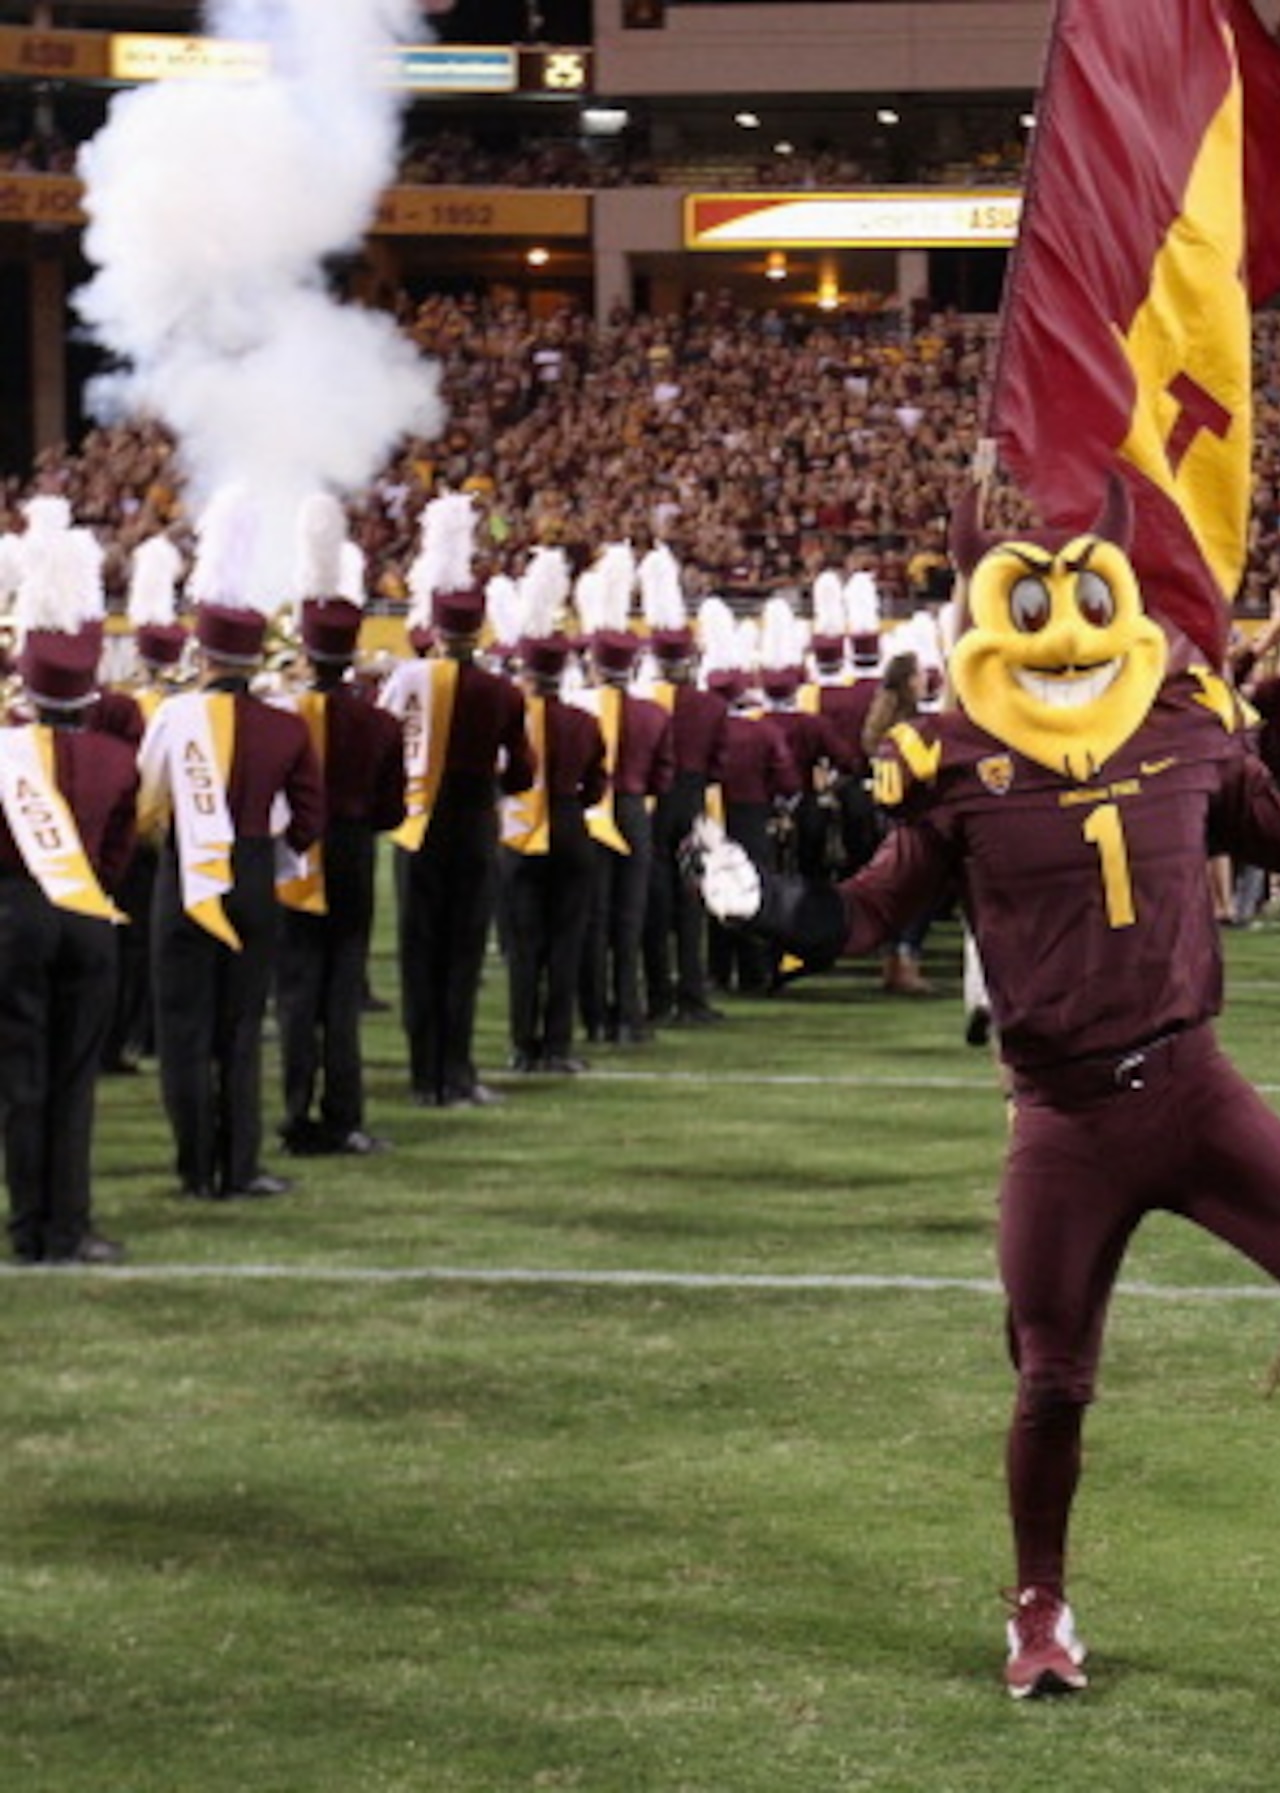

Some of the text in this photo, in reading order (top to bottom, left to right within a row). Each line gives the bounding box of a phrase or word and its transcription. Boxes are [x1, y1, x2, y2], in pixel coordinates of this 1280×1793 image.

[16, 777, 63, 850] ASU
[183, 738, 217, 816] ASU
[1083, 804, 1137, 928] 1
